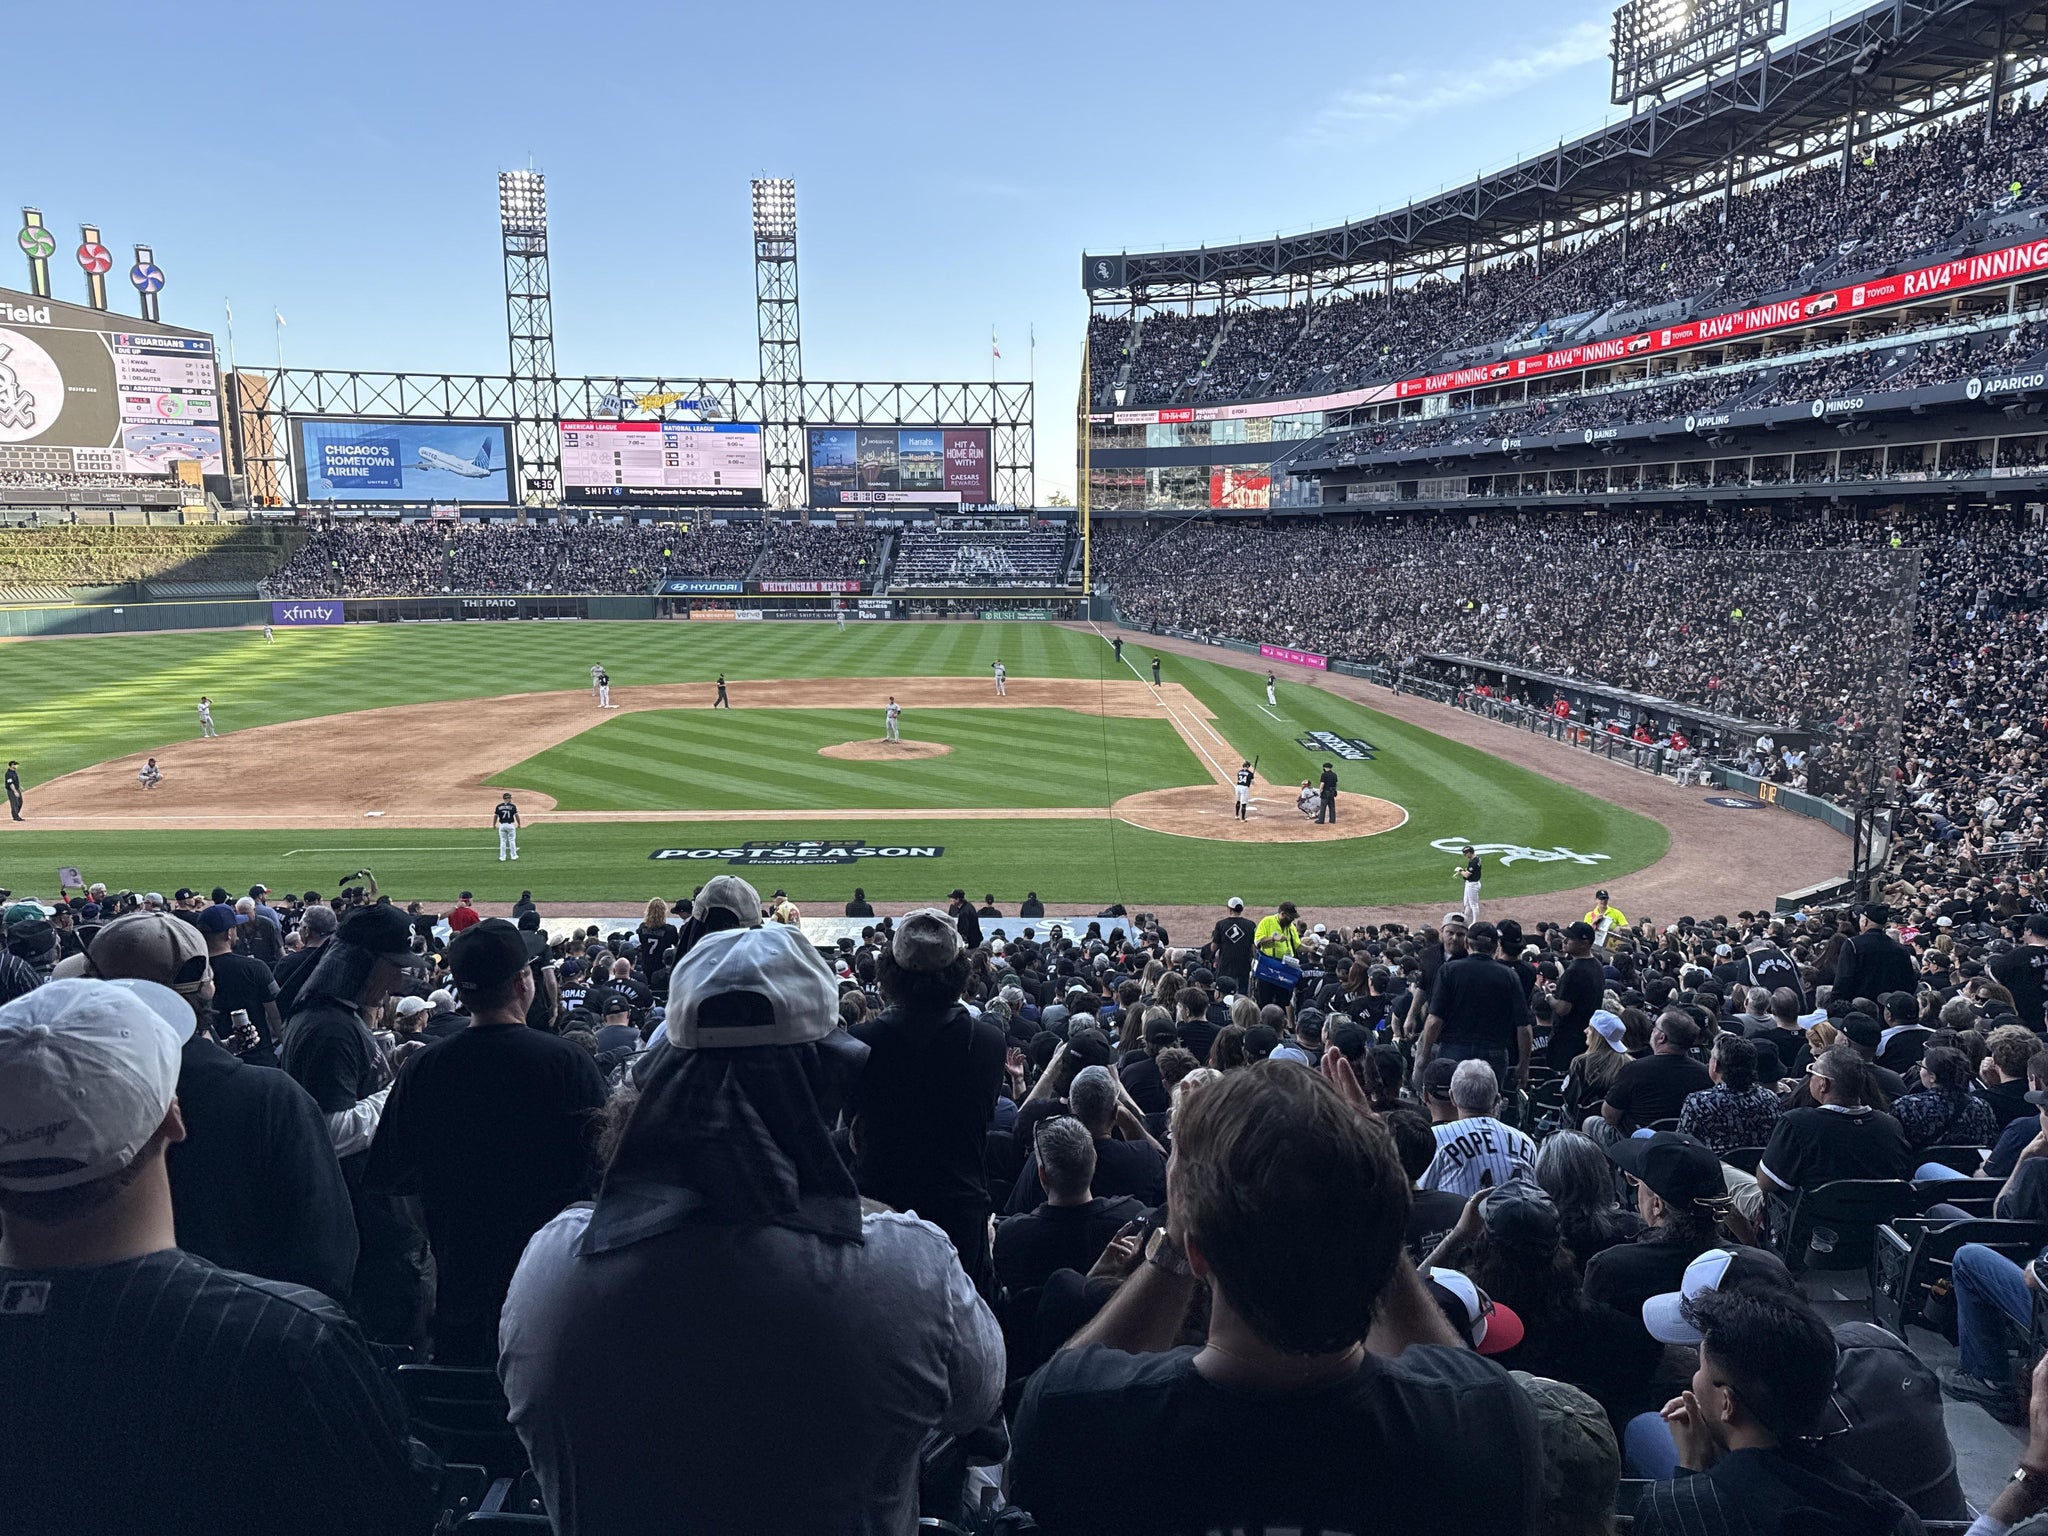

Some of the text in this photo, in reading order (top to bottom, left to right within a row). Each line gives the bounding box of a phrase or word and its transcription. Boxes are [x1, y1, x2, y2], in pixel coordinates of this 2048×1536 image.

[1970, 242, 2048, 281] INNING
[1867, 284, 1895, 299] TOYOTA
[1745, 302, 1800, 329] INNING
[1672, 330, 1694, 340] TOYOTA
[134, 337, 184, 348] GUARDIANS
[1582, 340, 1624, 362] INNING
[1526, 360, 1542, 370] TOYOTA
[1454, 368, 1488, 386] INNING
[1984, 374, 2045, 394] APARICIO
[676, 399, 700, 410] TIME
[1696, 414, 1730, 427] APPLING
[1594, 430, 1617, 440] BAINES
[1510, 439, 1521, 448] FOX
[325, 445, 390, 456] CHICAGO'S
[420, 450, 438, 460] UNITED
[946, 449, 984, 459] HOME RUN
[326, 456, 394, 467] HOMETOWN
[327, 466, 370, 477] AIRLINE
[533, 480, 554, 490] 4:36
[957, 502, 1016, 514] Lite LANDING
[762, 582, 818, 592] WHITTINGHAM
[821, 582, 846, 592] MEATS
[463, 599, 516, 608] THE PATIO
[282, 606, 334, 622] xfinity
[502, 810, 511, 819] 71
[656, 847, 935, 859] POSTSEASON
[648, 938, 658, 954] 7
[1444, 1132, 1498, 1168] POPE
